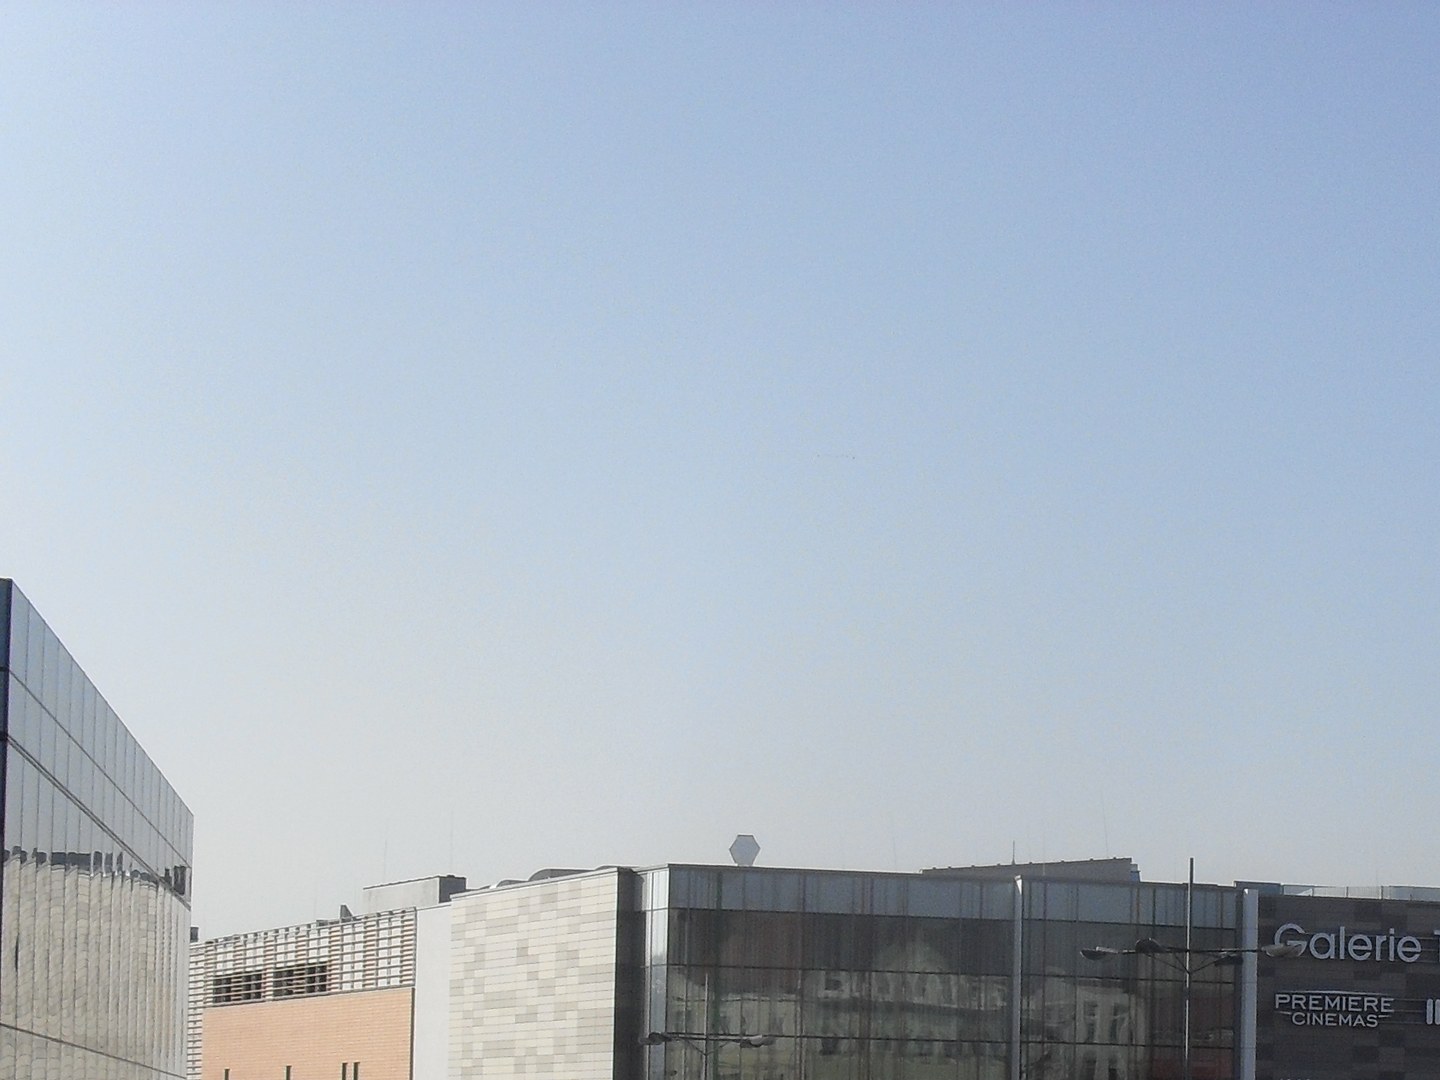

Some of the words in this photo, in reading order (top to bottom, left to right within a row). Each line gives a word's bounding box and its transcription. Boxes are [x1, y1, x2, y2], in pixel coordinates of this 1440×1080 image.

[1273, 922, 1422, 964] Galerie
[1274, 993, 1395, 1014] PREMIERE
[1291, 1012, 1379, 1028] CINEMAS
